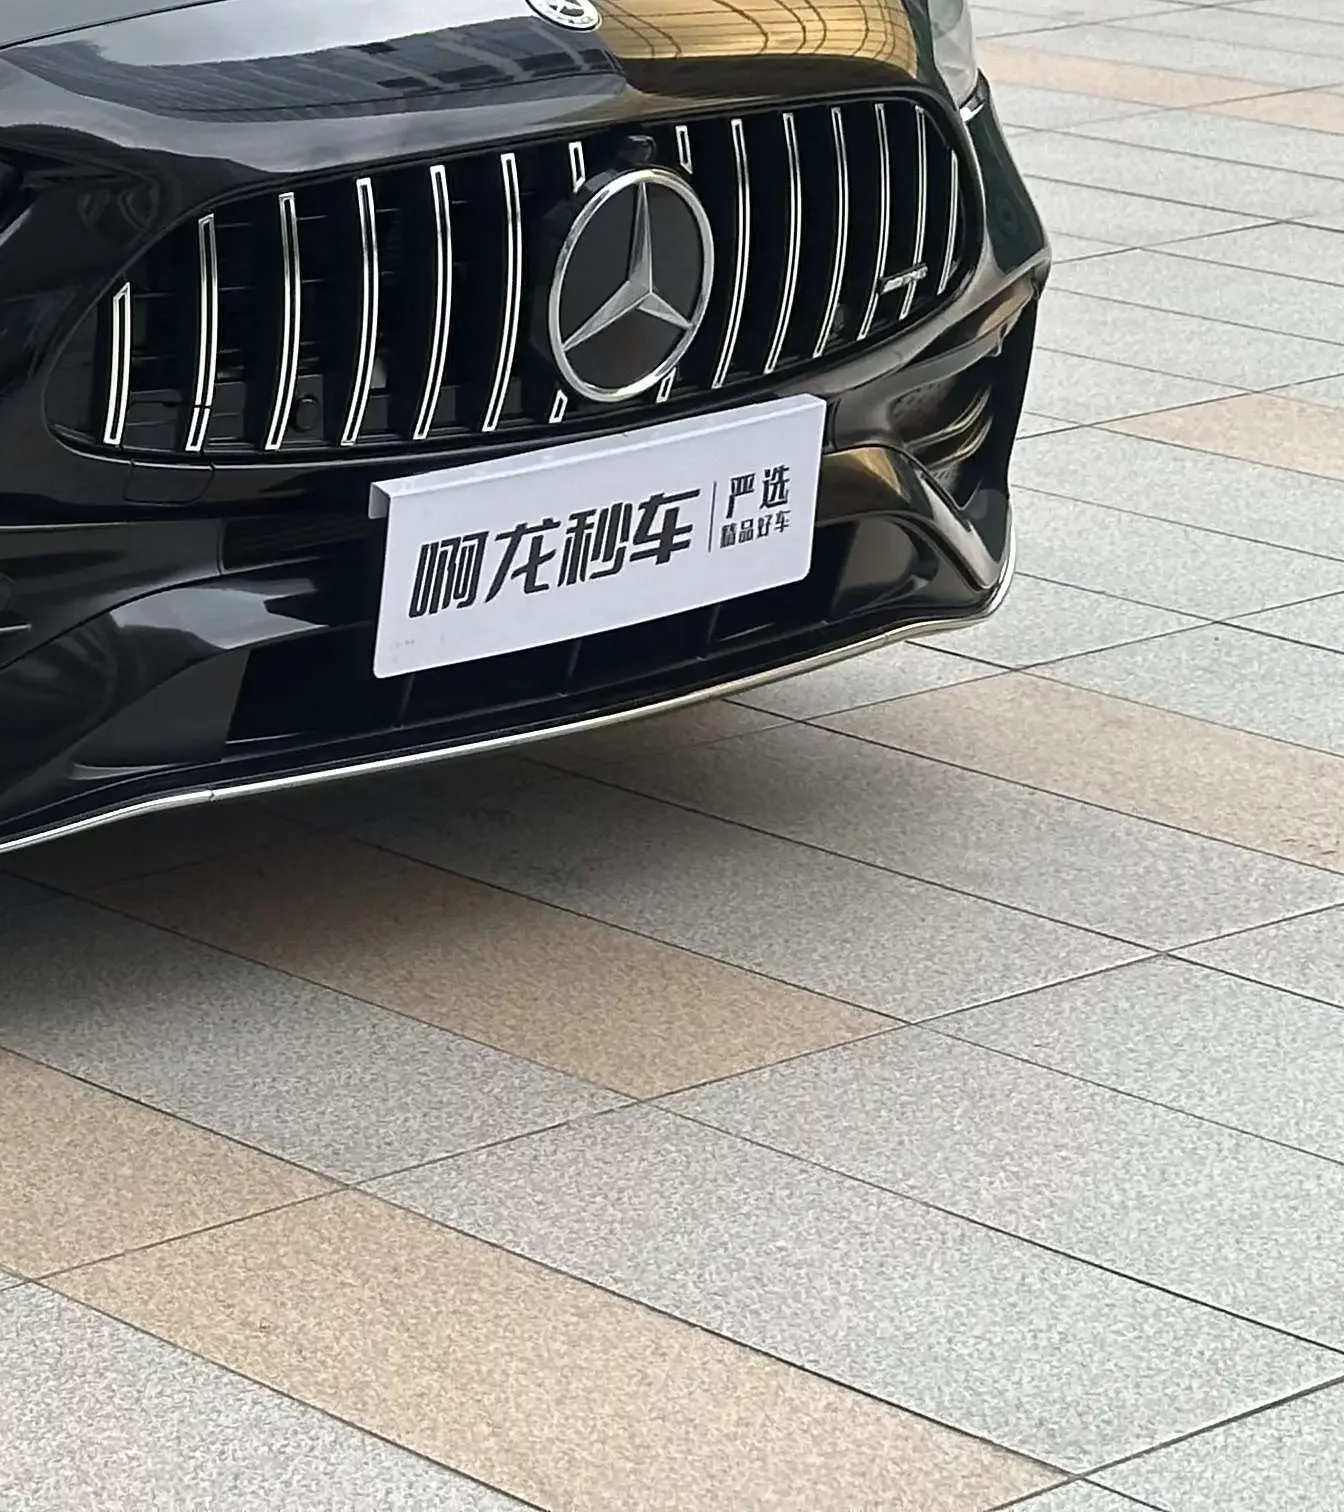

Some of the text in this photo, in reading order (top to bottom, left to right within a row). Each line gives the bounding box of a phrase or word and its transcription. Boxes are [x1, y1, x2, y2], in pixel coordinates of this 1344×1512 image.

[725, 464, 790, 519] 严选
[719, 510, 791, 548] 精品好车
